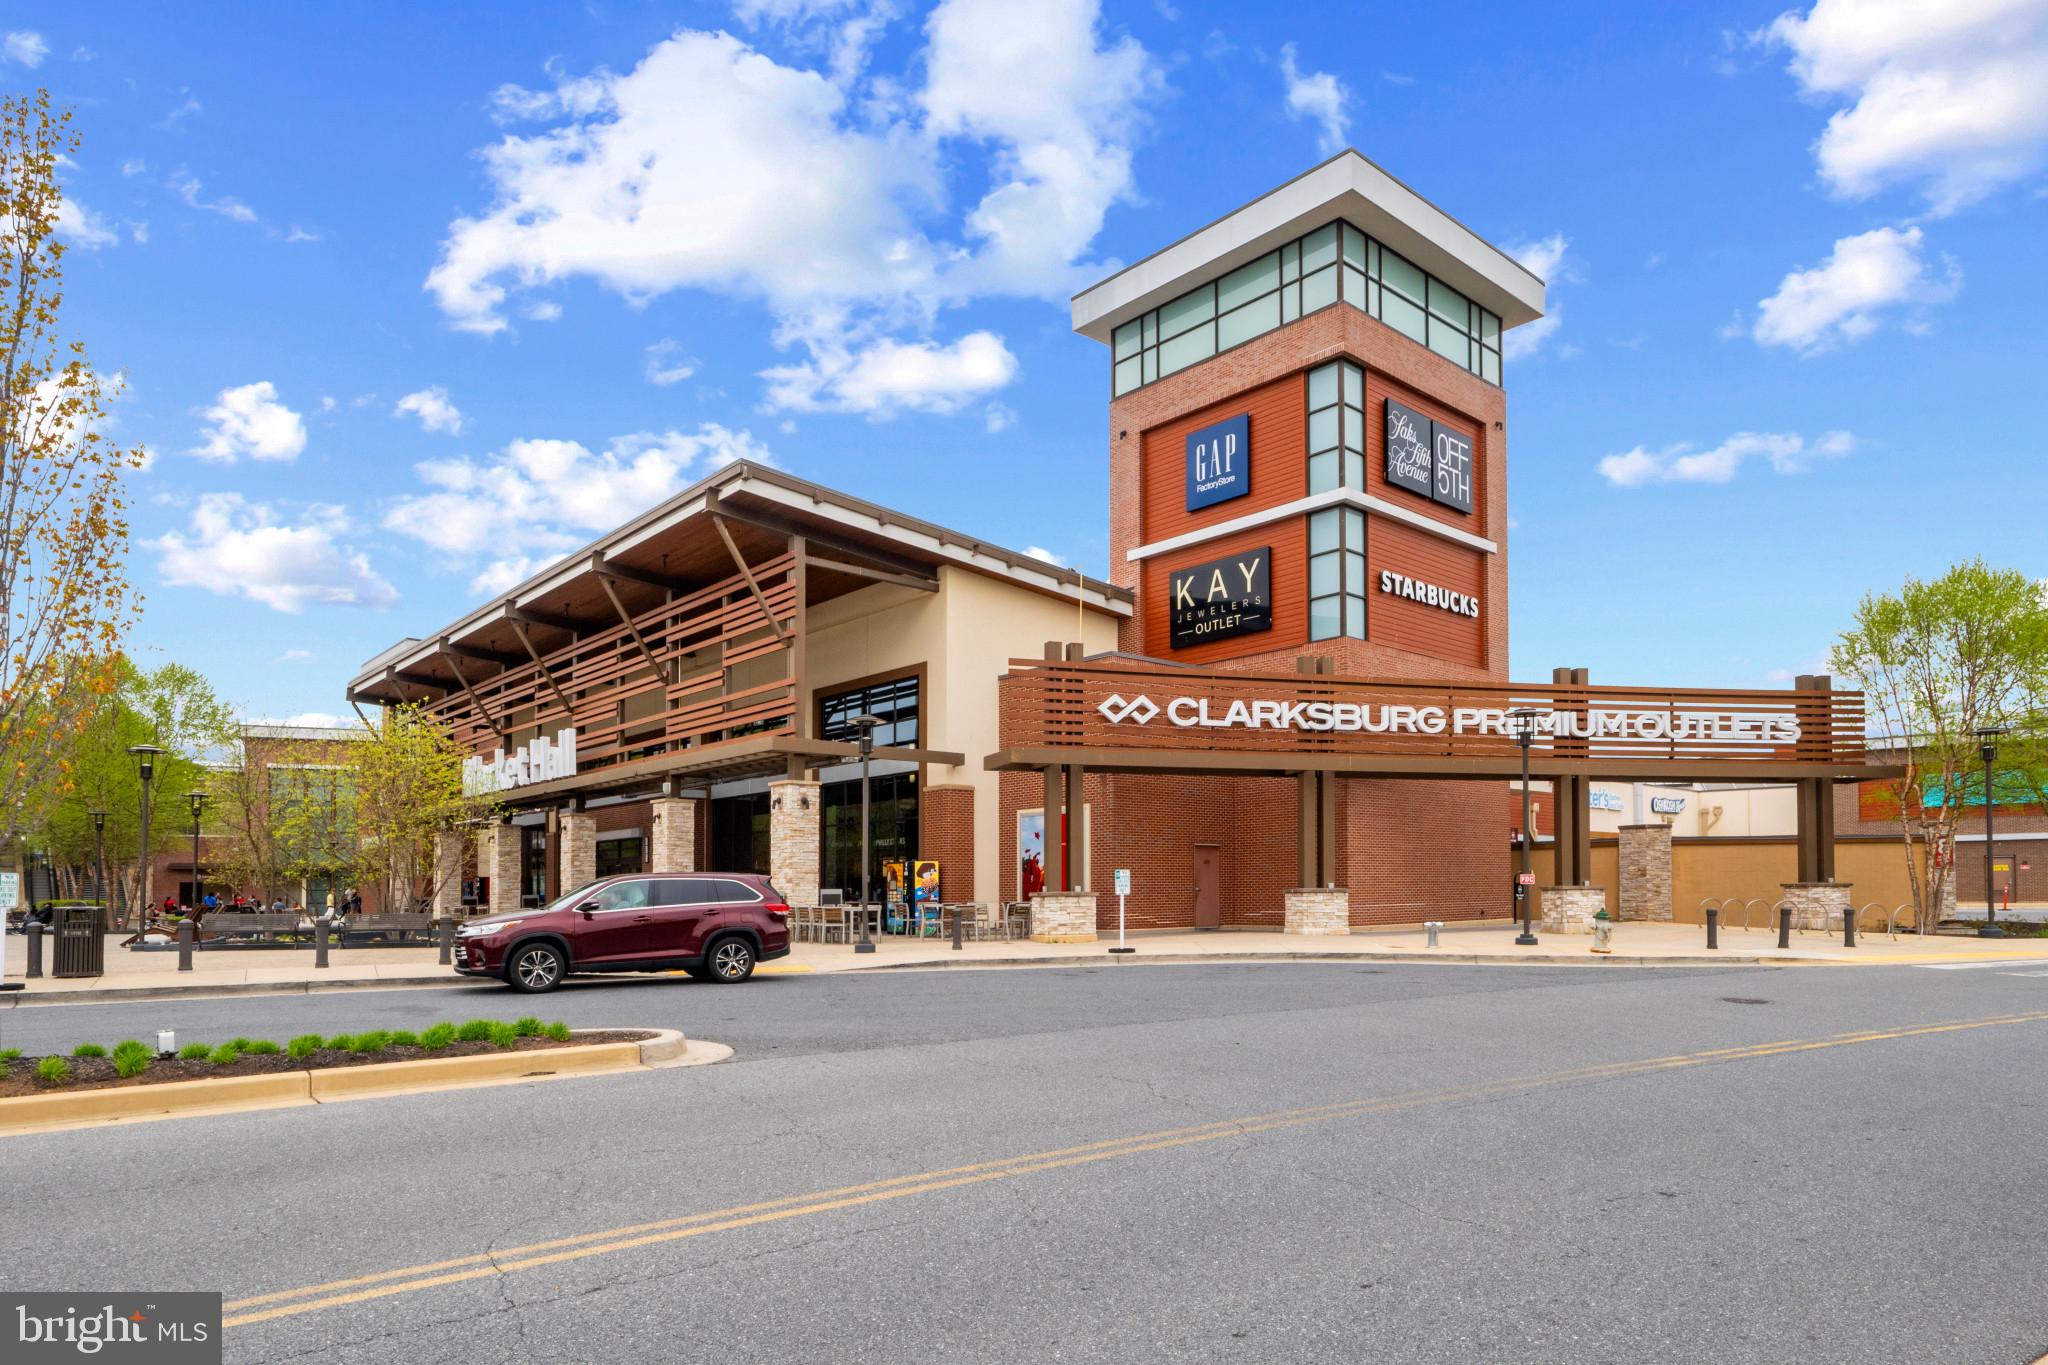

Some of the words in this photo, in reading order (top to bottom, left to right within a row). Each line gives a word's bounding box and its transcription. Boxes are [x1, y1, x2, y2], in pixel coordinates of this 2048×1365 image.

[1388, 410, 1417, 443] Saks
[1196, 433, 1236, 482] GAP
[1388, 445, 1429, 484] Avenue
[1403, 442, 1432, 469] Fifth
[1437, 433, 1469, 471] OFF
[1437, 462, 1470, 504] 5TH
[1176, 558, 1260, 610] KAY
[1381, 570, 1479, 618] STARBUCKS
[1177, 595, 1261, 624] JEWELERS
[1195, 614, 1242, 635] OUTLET
[1167, 696, 1446, 734] CLARKSBURG
[1634, 713, 1802, 741] OUTLETS
